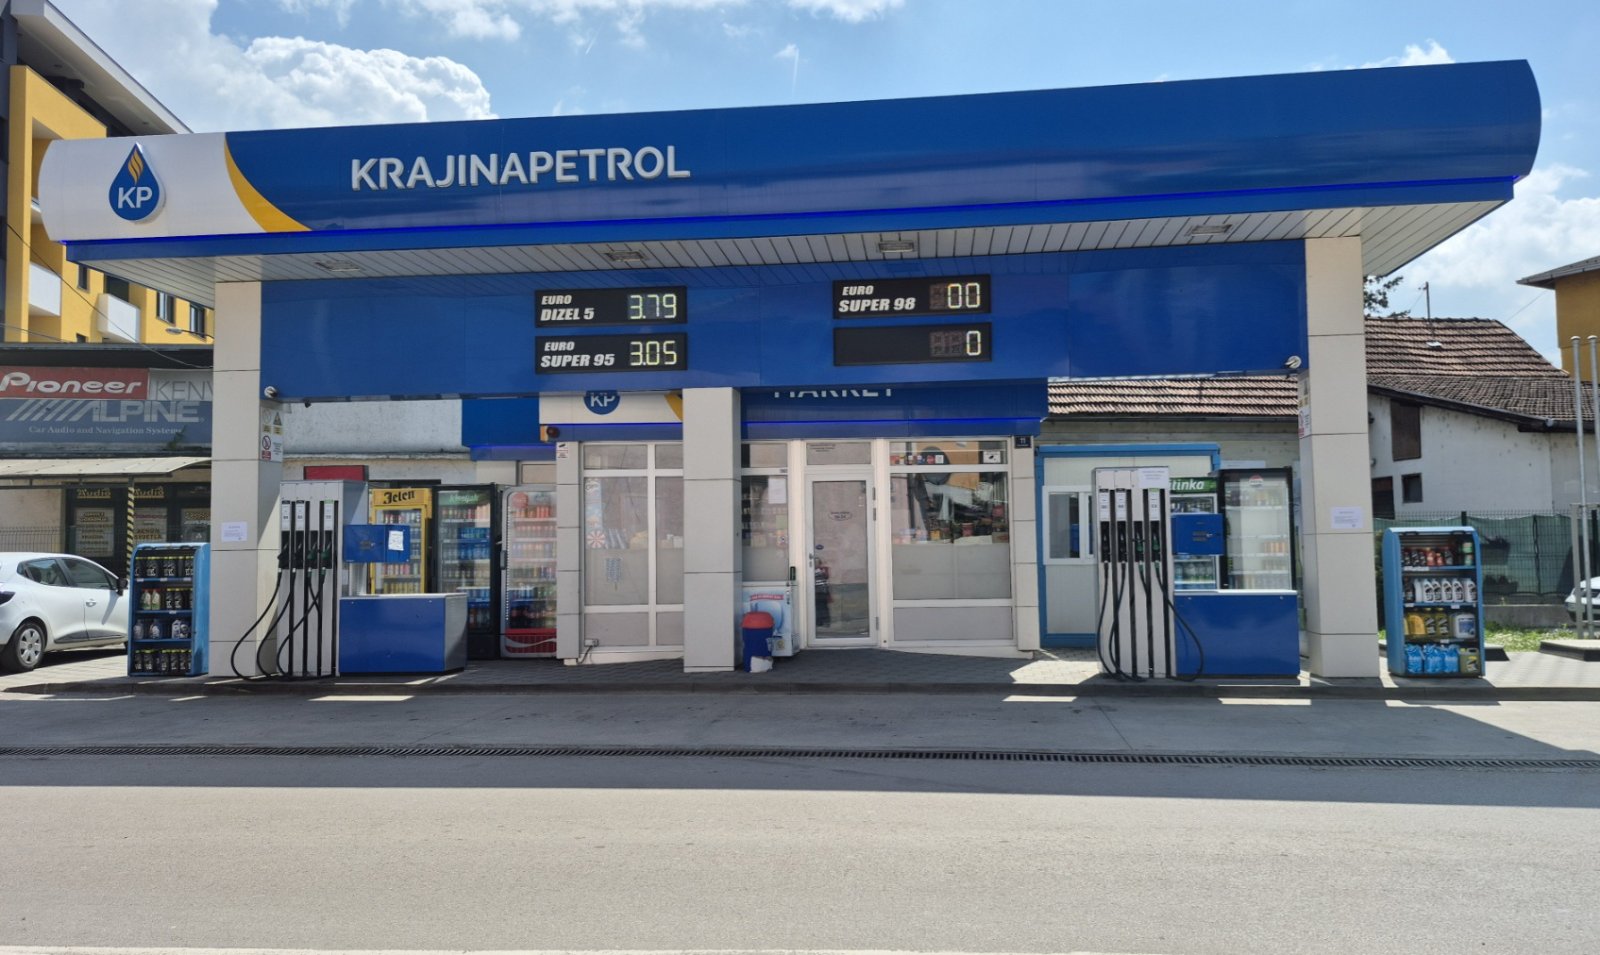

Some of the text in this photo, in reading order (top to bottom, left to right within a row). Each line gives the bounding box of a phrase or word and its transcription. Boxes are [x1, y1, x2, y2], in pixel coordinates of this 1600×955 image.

[352, 145, 690, 191] KRAJINAPETROL
[117, 186, 153, 209] KP
[841, 285, 874, 296] EURO
[541, 295, 573, 305] EURO
[630, 293, 677, 320] 3.79
[838, 297, 916, 312] SUPER 98
[540, 307, 595, 321] DIZEL 5
[544, 341, 575, 352] EURO
[630, 340, 677, 366] 3.05
[540, 353, 615, 367] SUPER 95
[0, 371, 142, 394] Pioneer
[68, 401, 201, 423] ALPINE
[28, 426, 45, 434] Car
[47, 426, 75, 434] Audio
[95, 426, 144, 435] Navigation
[383, 490, 415, 504] Jelen
